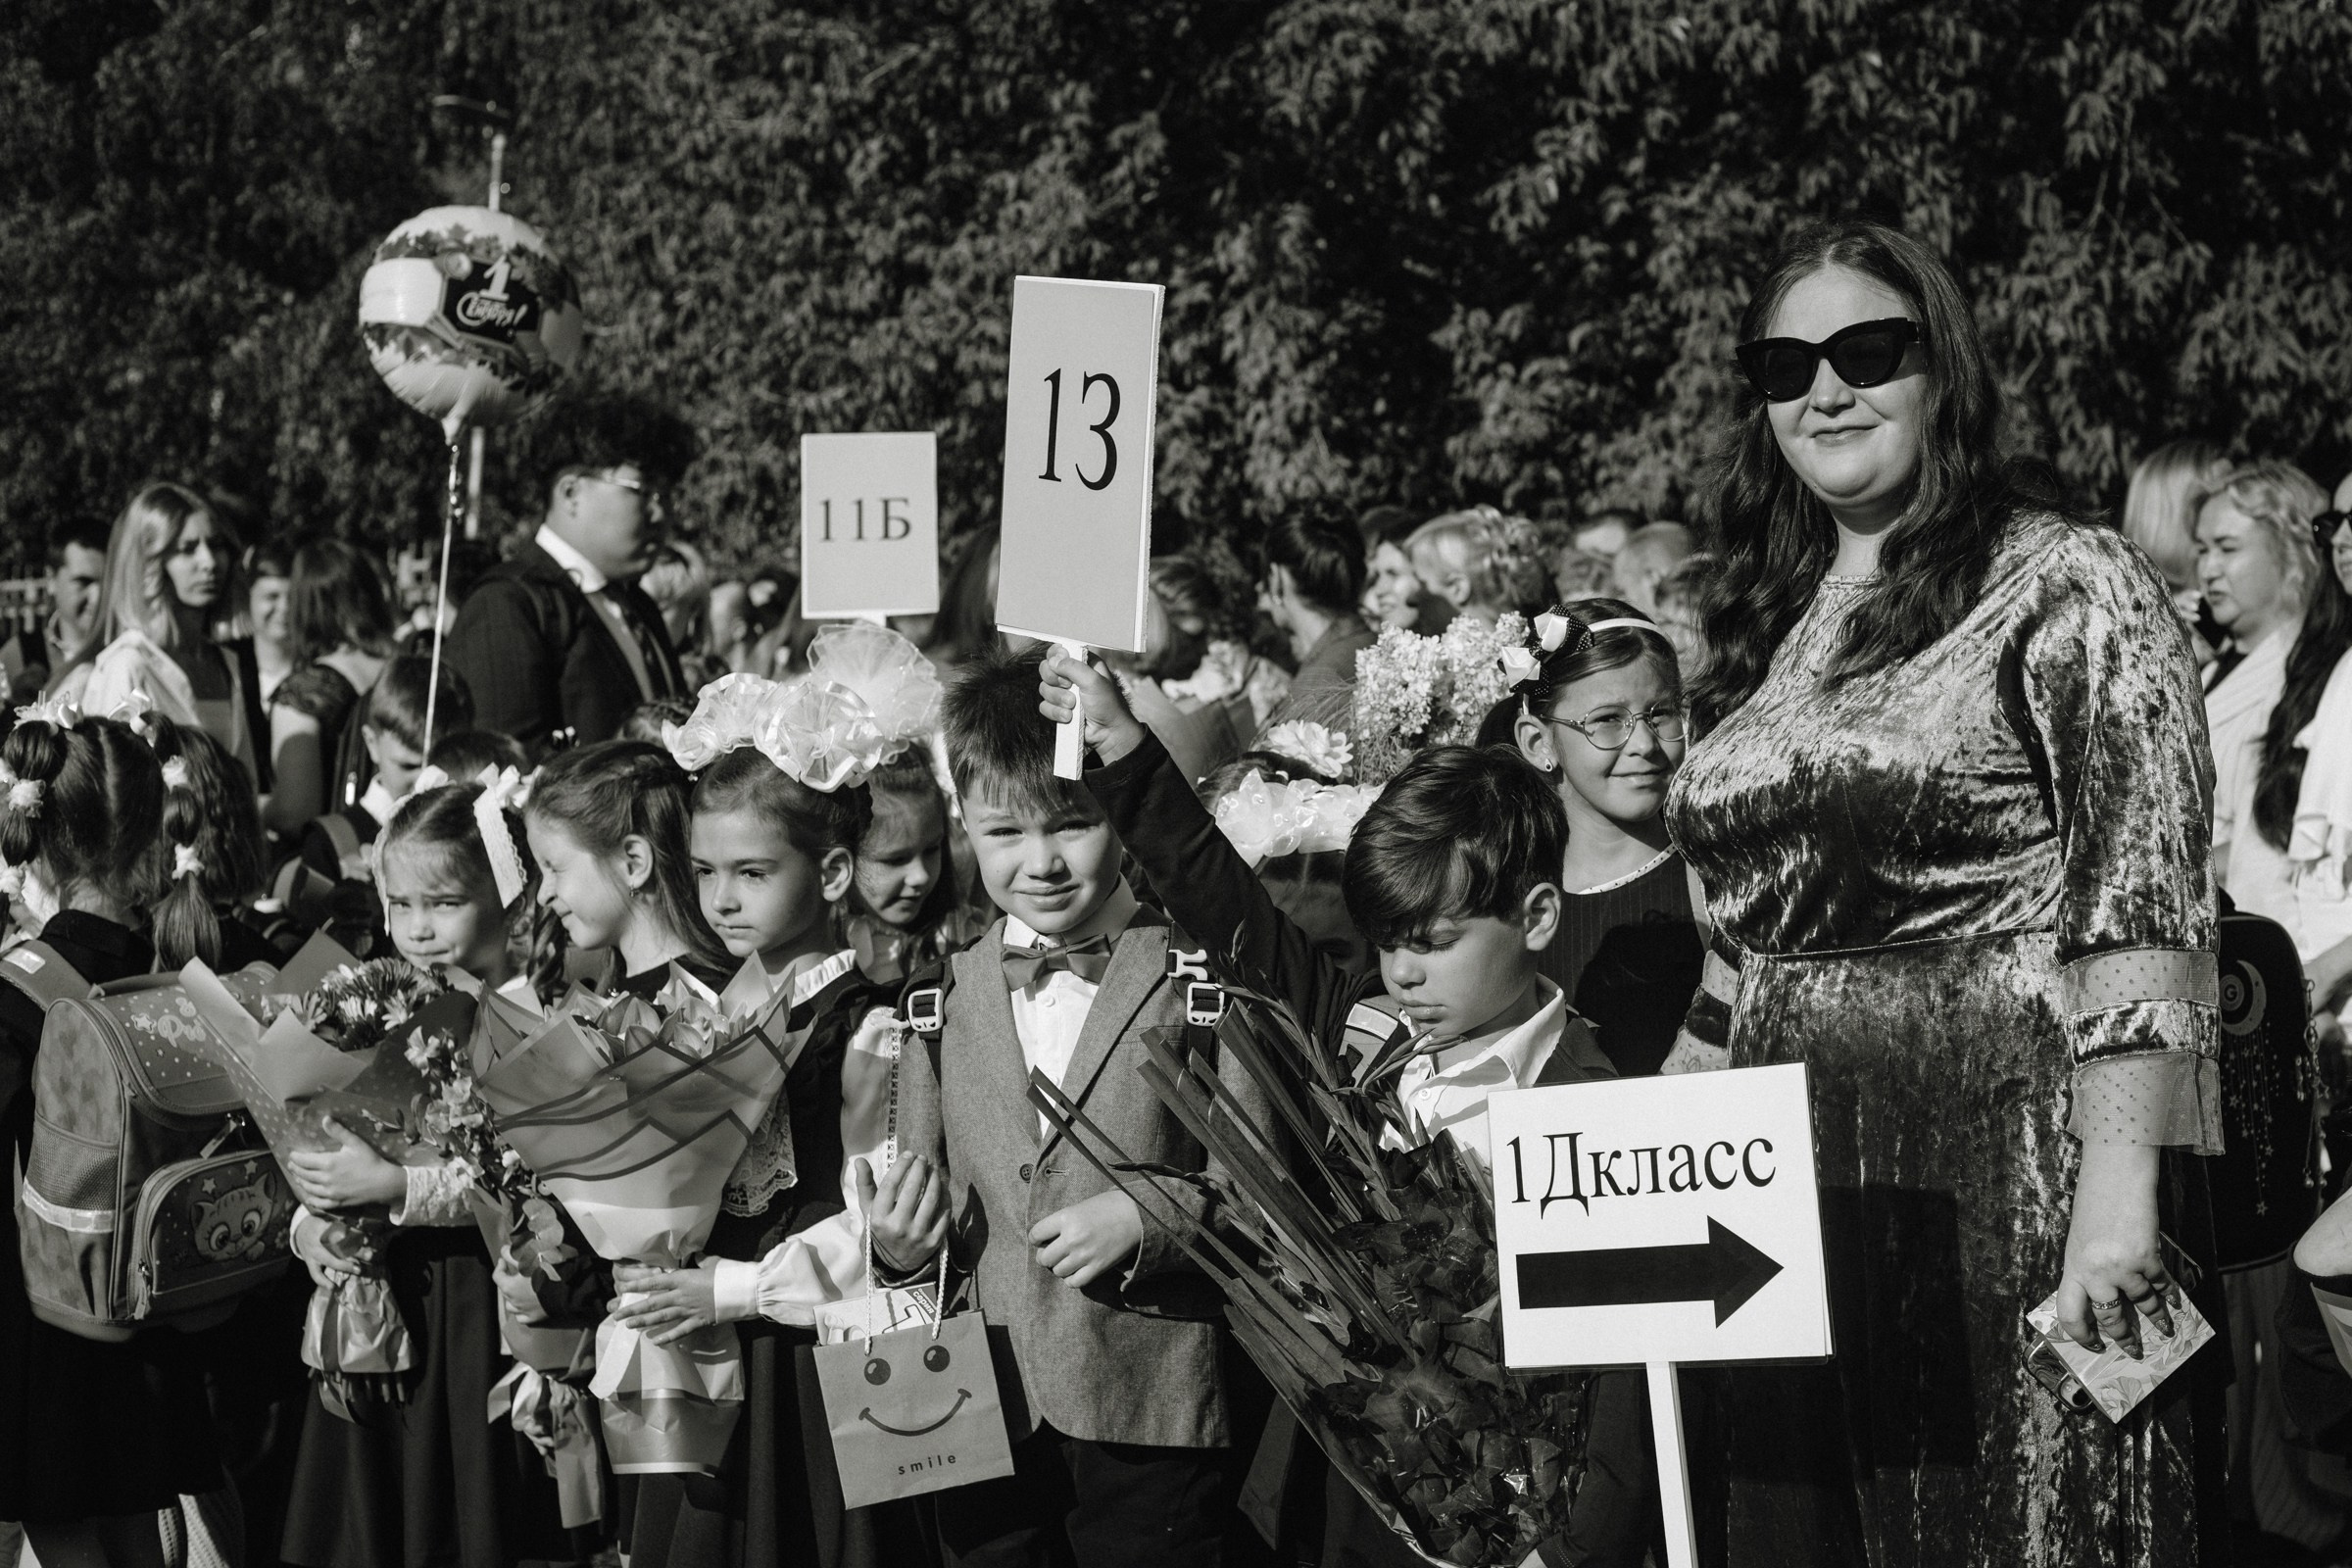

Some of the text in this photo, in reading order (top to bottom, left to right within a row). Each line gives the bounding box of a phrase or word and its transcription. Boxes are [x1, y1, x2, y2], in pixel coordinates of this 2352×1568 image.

[479, 254, 512, 302] 1
[1038, 368, 1121, 491] 13
[819, 497, 911, 542] 11Б
[912, 1291, 935, 1314] серия
[898, 1454, 956, 1475] smile
